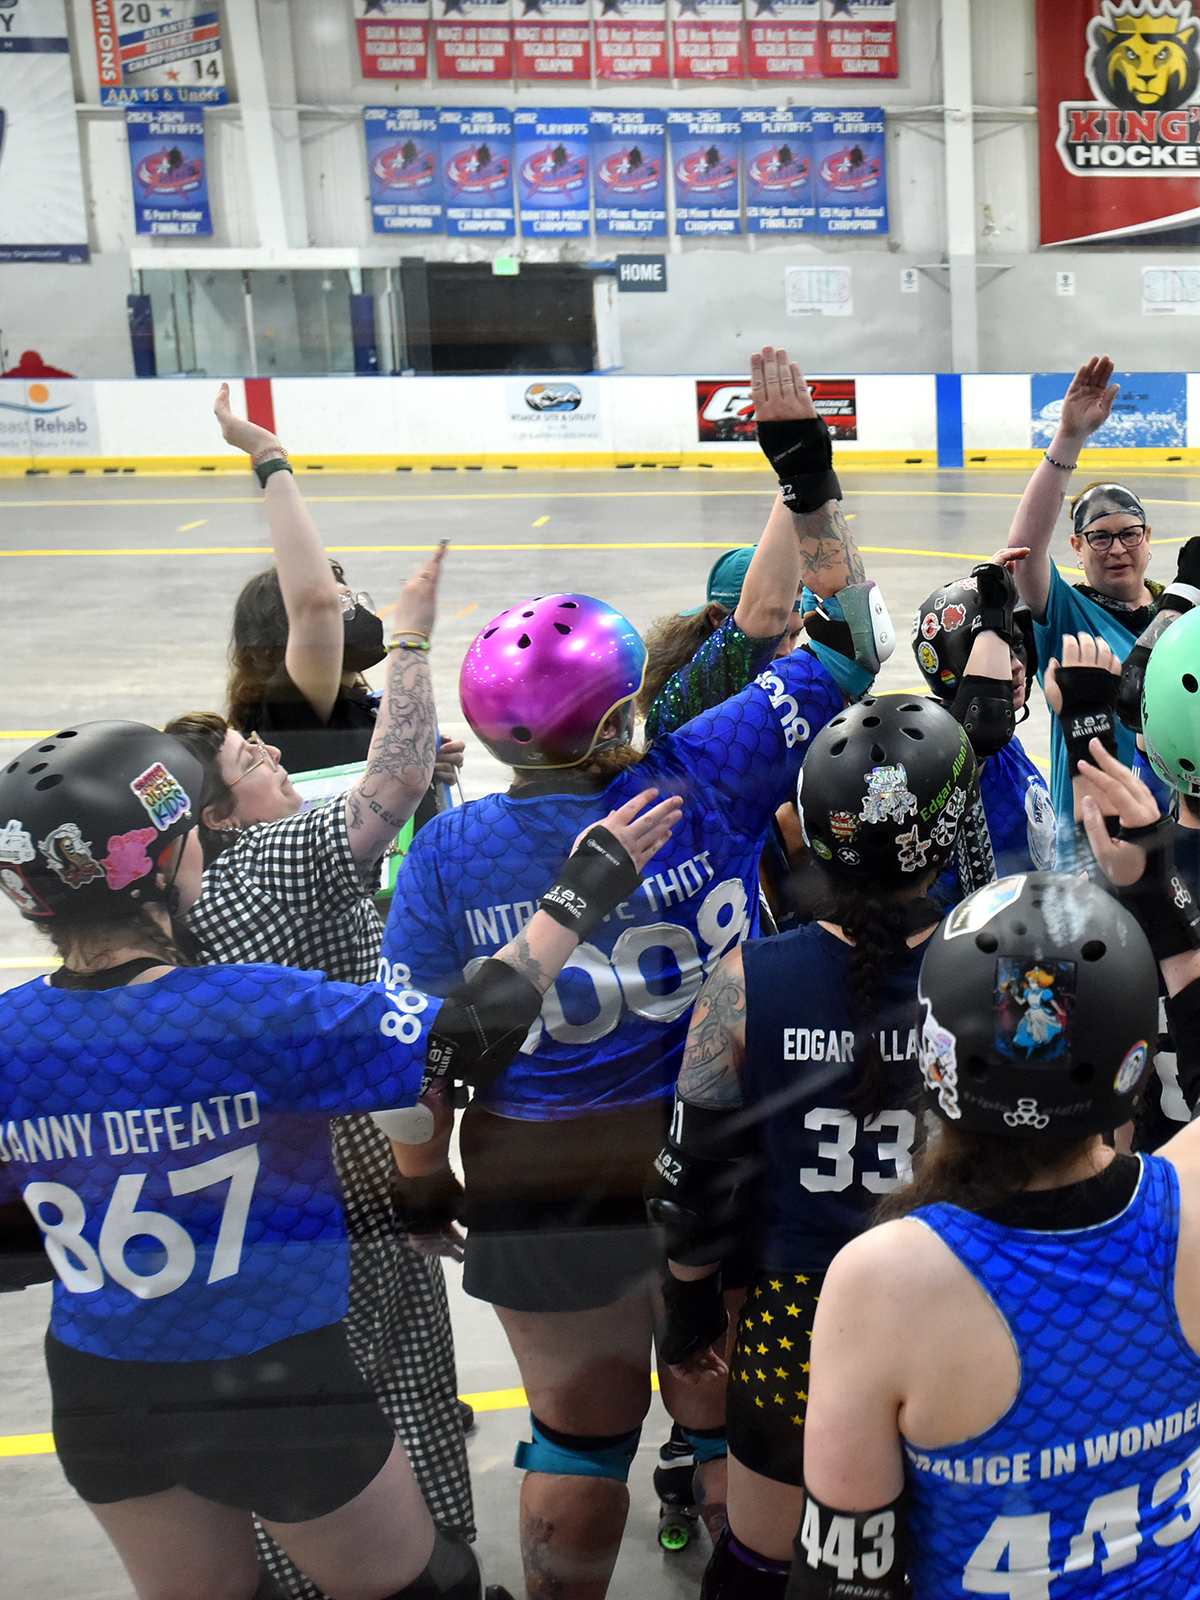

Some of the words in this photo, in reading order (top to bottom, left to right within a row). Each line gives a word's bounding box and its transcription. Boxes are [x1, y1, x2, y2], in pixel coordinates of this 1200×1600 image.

[121, 4, 151, 23] 20
[194, 60, 219, 79] 14
[107, 89, 139, 102] AAA
[163, 89, 173, 102] &
[178, 89, 220, 101] Under
[149, 123, 204, 135] PLAYOFFS
[385, 119, 437, 131] PLAYOFFS
[460, 123, 511, 135] PLAYOFFS
[535, 123, 589, 135] PLAYOFFS
[611, 123, 665, 135] PLAYOFFS
[688, 123, 741, 135] PLAYOFFS
[761, 122, 813, 133] PLAYOFFS
[833, 122, 884, 133] PLAYOFFS
[609, 220, 654, 231] FINALIST
[760, 217, 804, 229] FINALIST
[620, 263, 663, 282] HOME
[34, 417, 87, 435] Rehab
[1071, 727, 1093, 739] KILLER
[1093, 721, 1111, 732] PADS
[1073, 713, 1107, 730] 187
[920, 780, 952, 823] Edgar
[953, 746, 968, 782] Allan
[153, 789, 187, 825] KIDS
[642, 850, 716, 913] THOT
[543, 893, 566, 905] KILLER
[564, 902, 582, 919] PADS
[550, 884, 587, 910] 187
[783, 1028, 855, 1063] EDGAR
[103, 1091, 261, 1156] DEFEATO
[23, 1143, 260, 1300] 867
[1040, 1444, 1077, 1477] IN
[800, 1500, 896, 1580] 443
